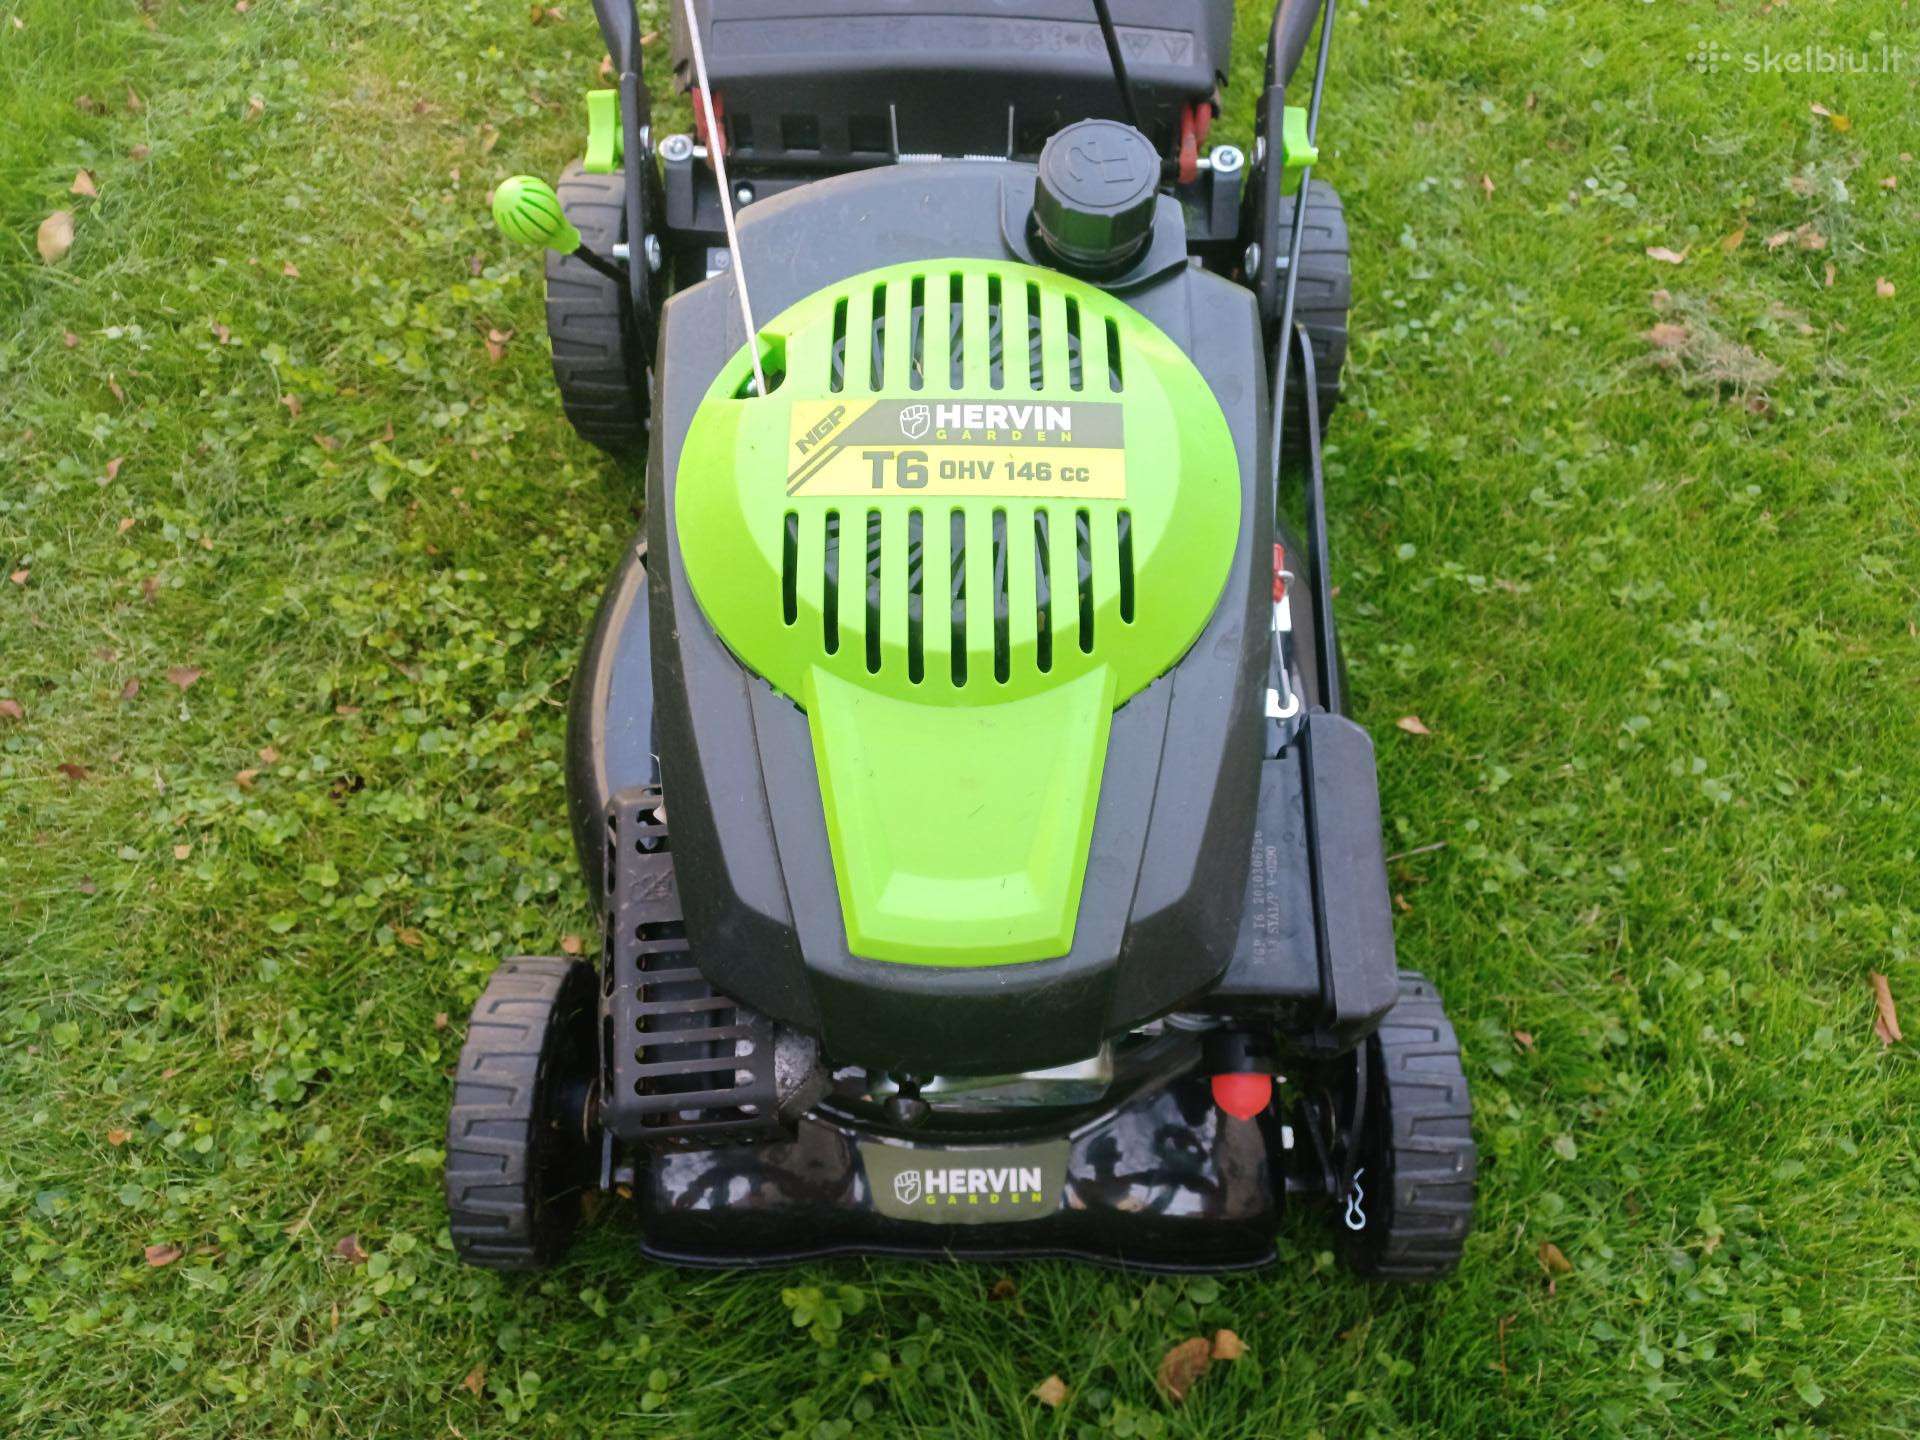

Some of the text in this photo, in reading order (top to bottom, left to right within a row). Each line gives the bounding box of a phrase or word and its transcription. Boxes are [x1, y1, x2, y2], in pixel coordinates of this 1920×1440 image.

[795, 405, 846, 455] NGP
[935, 404, 1073, 430] HERVIN
[936, 431, 1073, 442] GARDEN
[862, 450, 1090, 489] T6 OHV 146 cc
[925, 1167, 1042, 1194] HERVIN
[926, 1193, 1042, 1205] GARDEN
